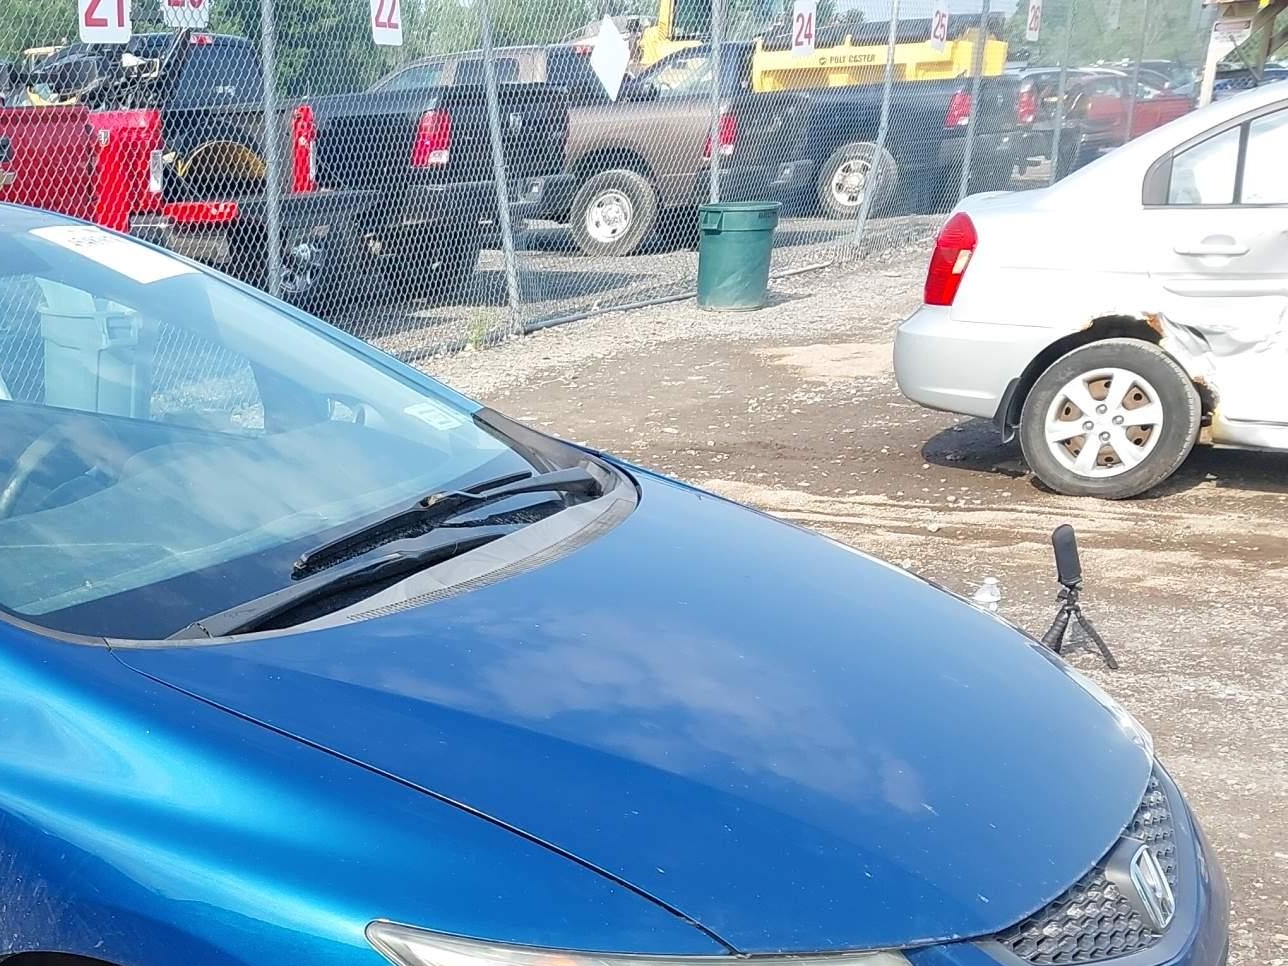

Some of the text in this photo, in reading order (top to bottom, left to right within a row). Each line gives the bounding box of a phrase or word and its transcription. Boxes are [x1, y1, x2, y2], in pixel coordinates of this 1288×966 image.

[795, 12, 812, 46] 24
[933, 10, 947, 42] 25
[1029, 5, 1040, 31] 26
